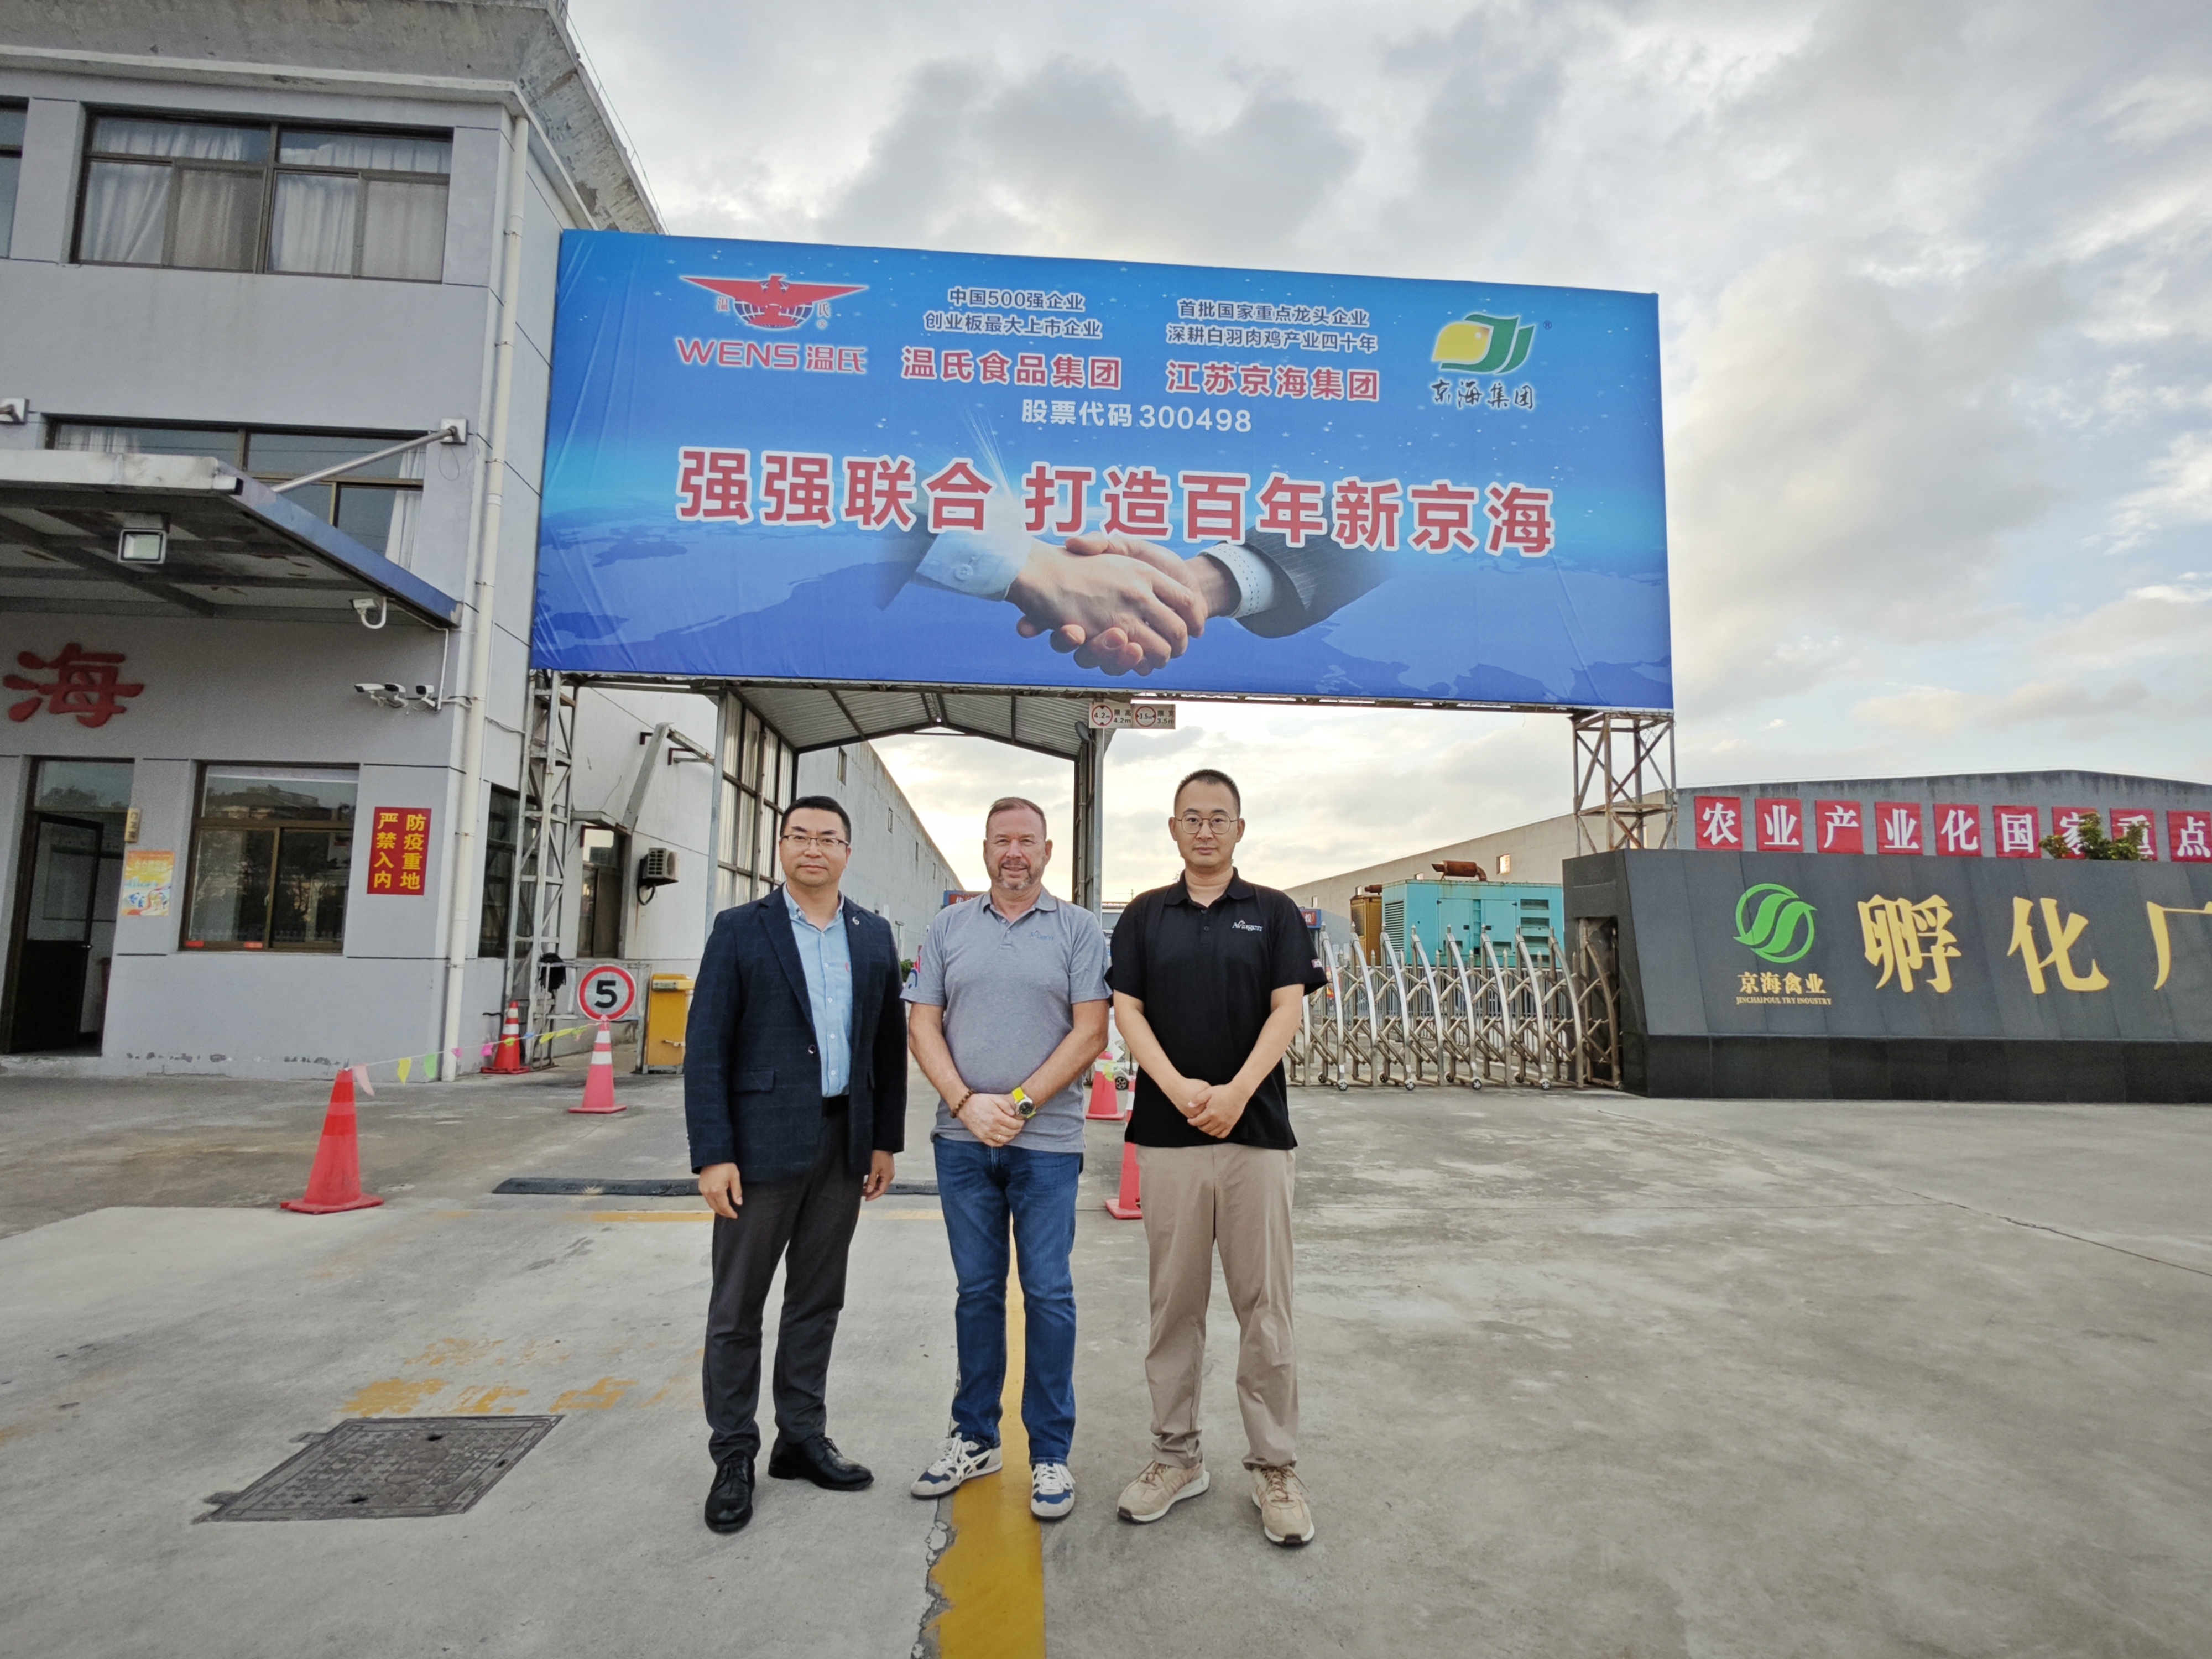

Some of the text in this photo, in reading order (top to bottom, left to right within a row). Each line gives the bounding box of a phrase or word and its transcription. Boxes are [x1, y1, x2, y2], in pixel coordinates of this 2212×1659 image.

[949, 288, 1085, 311] 中国500强企业
[1178, 299, 1369, 326] 首批国家重点龙头企业
[925, 312, 1102, 338] 创业板最大上市企业
[1167, 325, 1377, 352] 深耕白羽肉鸡产业四十年
[677, 338, 866, 373] WENS 温氏
[902, 348, 1120, 388] 温氏食品集团
[1166, 362, 1378, 400] 江苏京海集团
[1431, 379, 1534, 410] 京海集团
[680, 450, 1552, 555] 强强联合 打造百年新京海
[2, 643, 144, 728] 海
[373, 812, 399, 889] 严禁入内
[400, 813, 427, 890] 防疫重地
[1857, 894, 2212, 995] 孵化厂
[594, 980, 618, 1009] 5
[1737, 971, 1827, 994] 京海禽业
